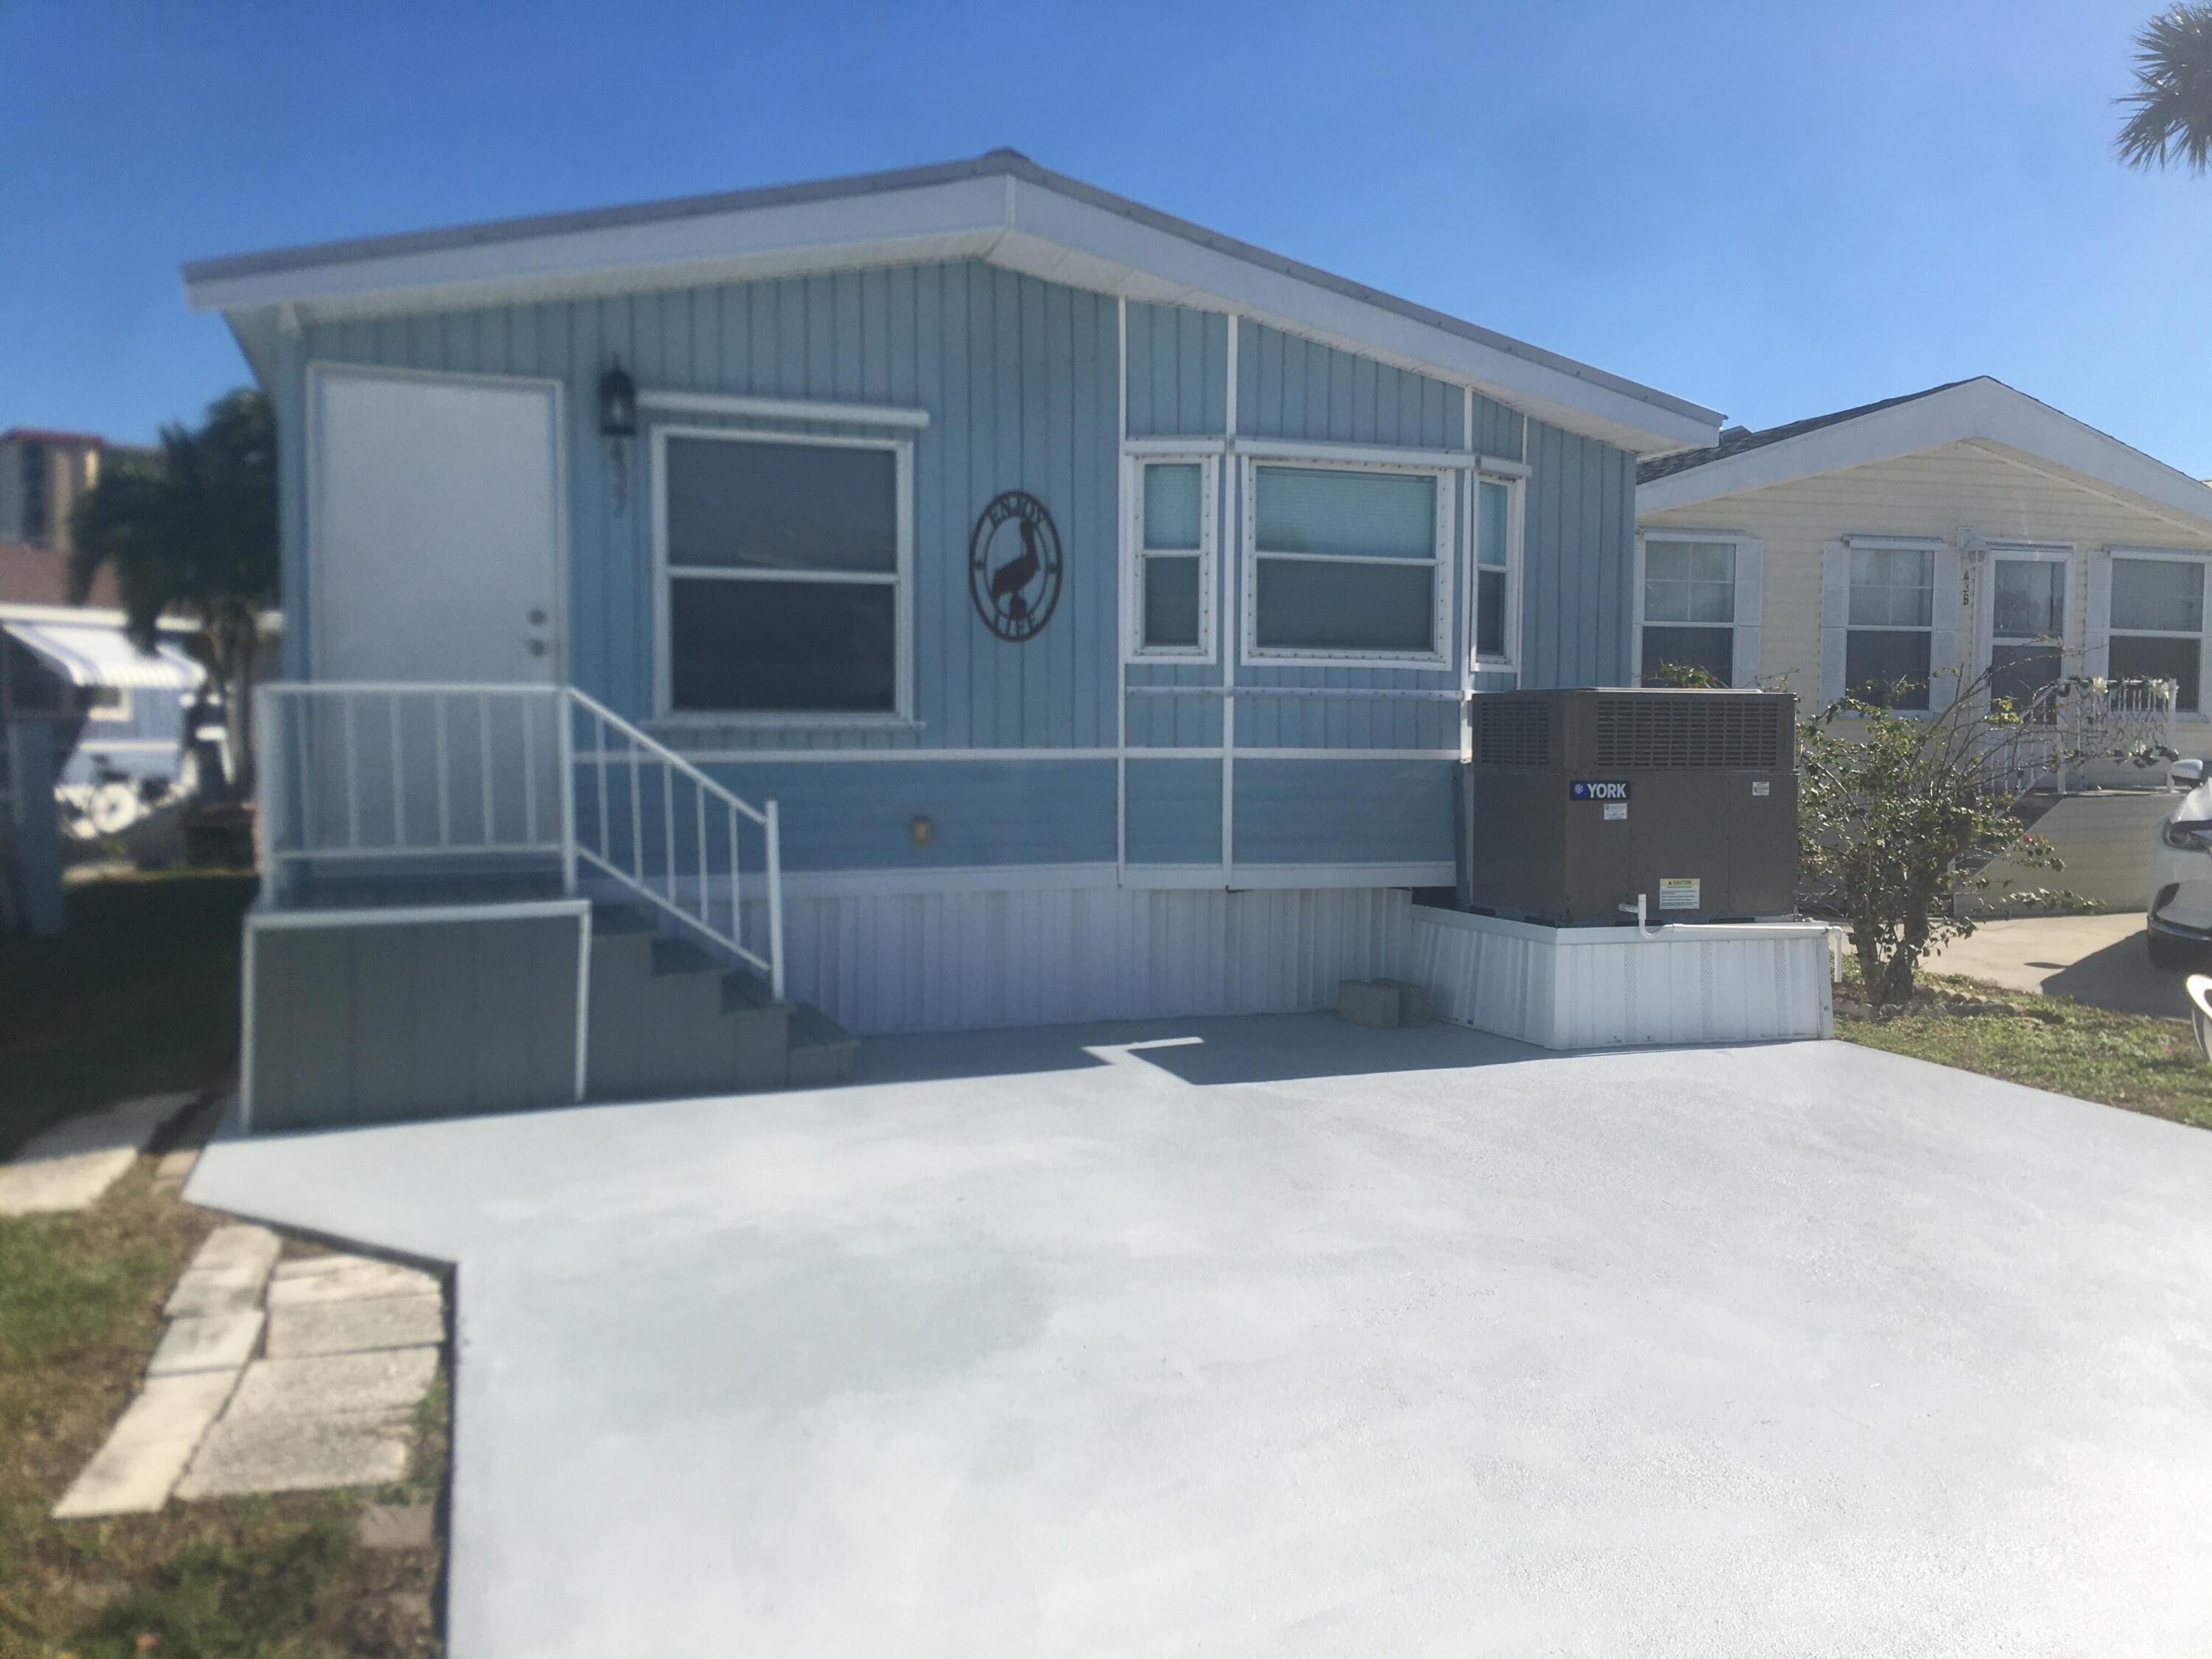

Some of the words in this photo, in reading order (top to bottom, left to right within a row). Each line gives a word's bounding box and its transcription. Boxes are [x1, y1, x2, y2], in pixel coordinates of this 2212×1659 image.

[990, 495, 1046, 526] ENJOY
[993, 613, 1036, 639] LIFE
[1587, 783, 1627, 799] YORK
